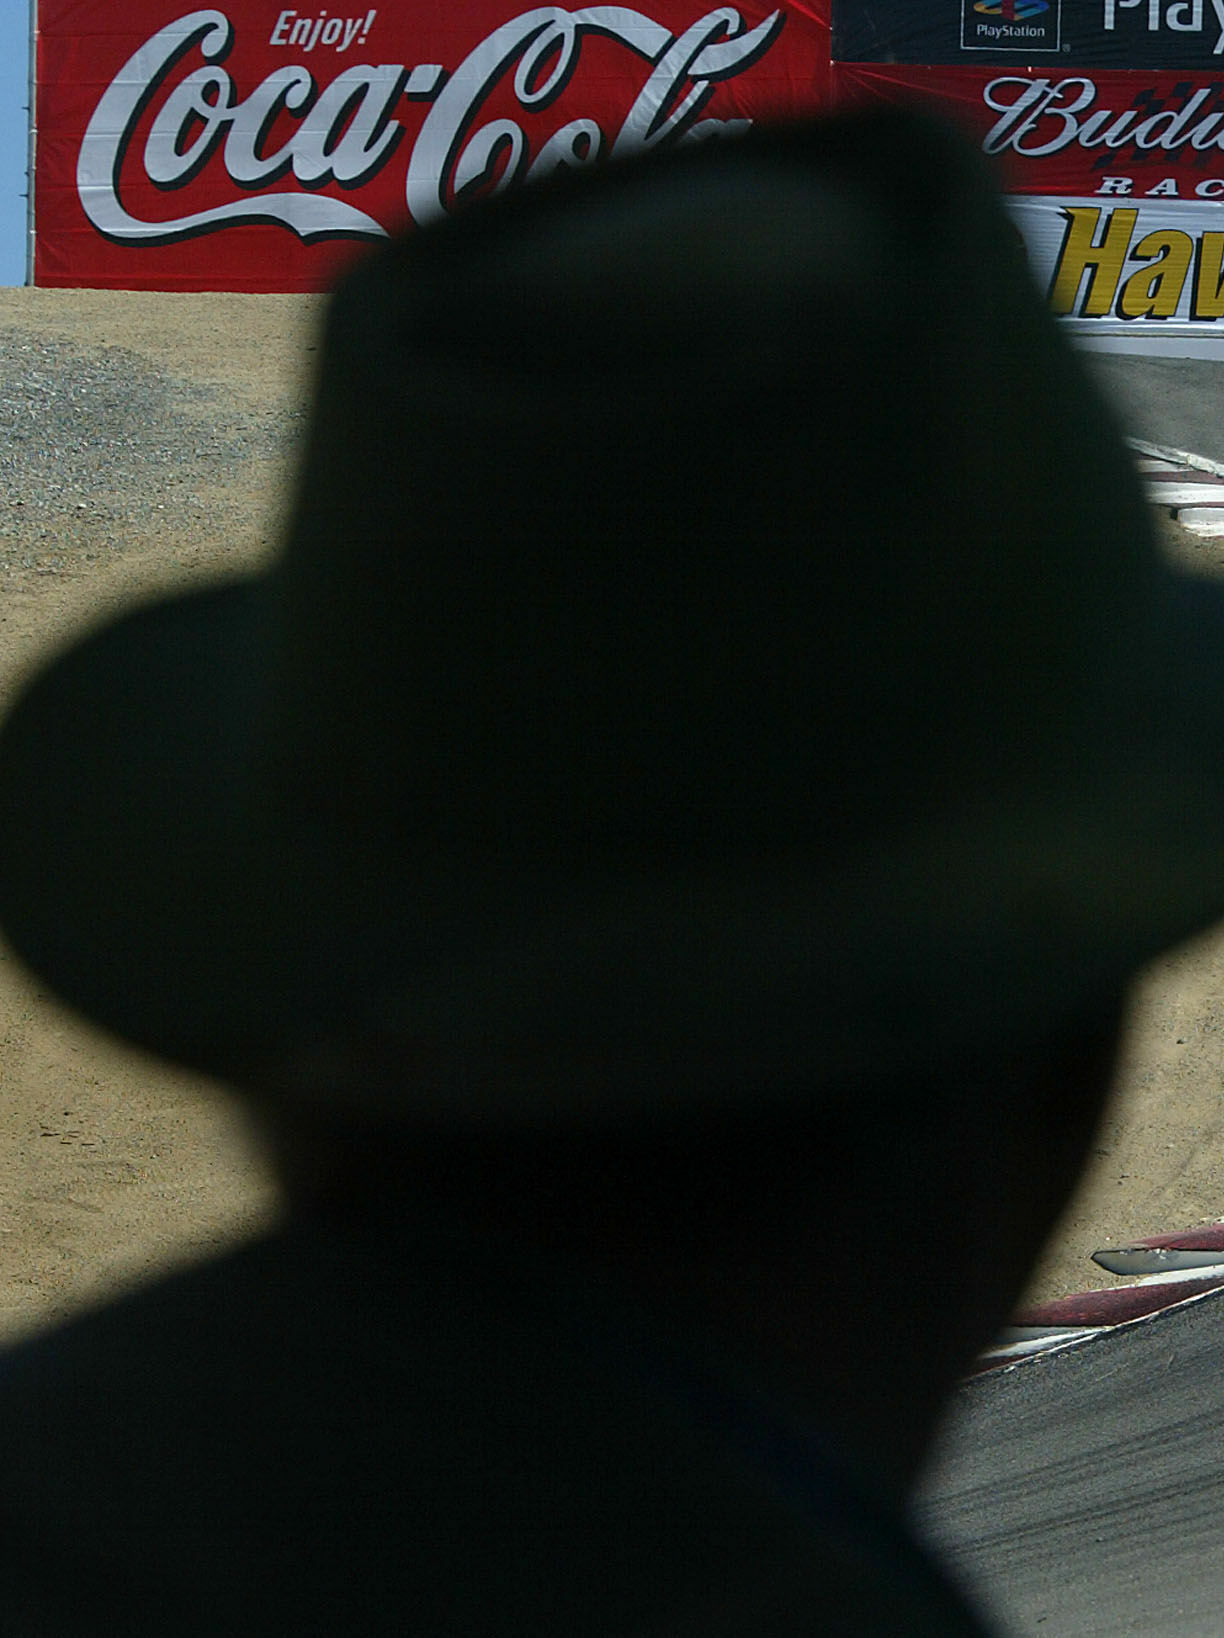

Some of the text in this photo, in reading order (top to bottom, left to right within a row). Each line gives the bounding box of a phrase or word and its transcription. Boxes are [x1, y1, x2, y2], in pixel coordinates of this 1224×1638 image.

[269, 8, 377, 53] Enjoy!
[976, 23, 1046, 40] PlayStation
[76, 6, 790, 244] Coca-Col
